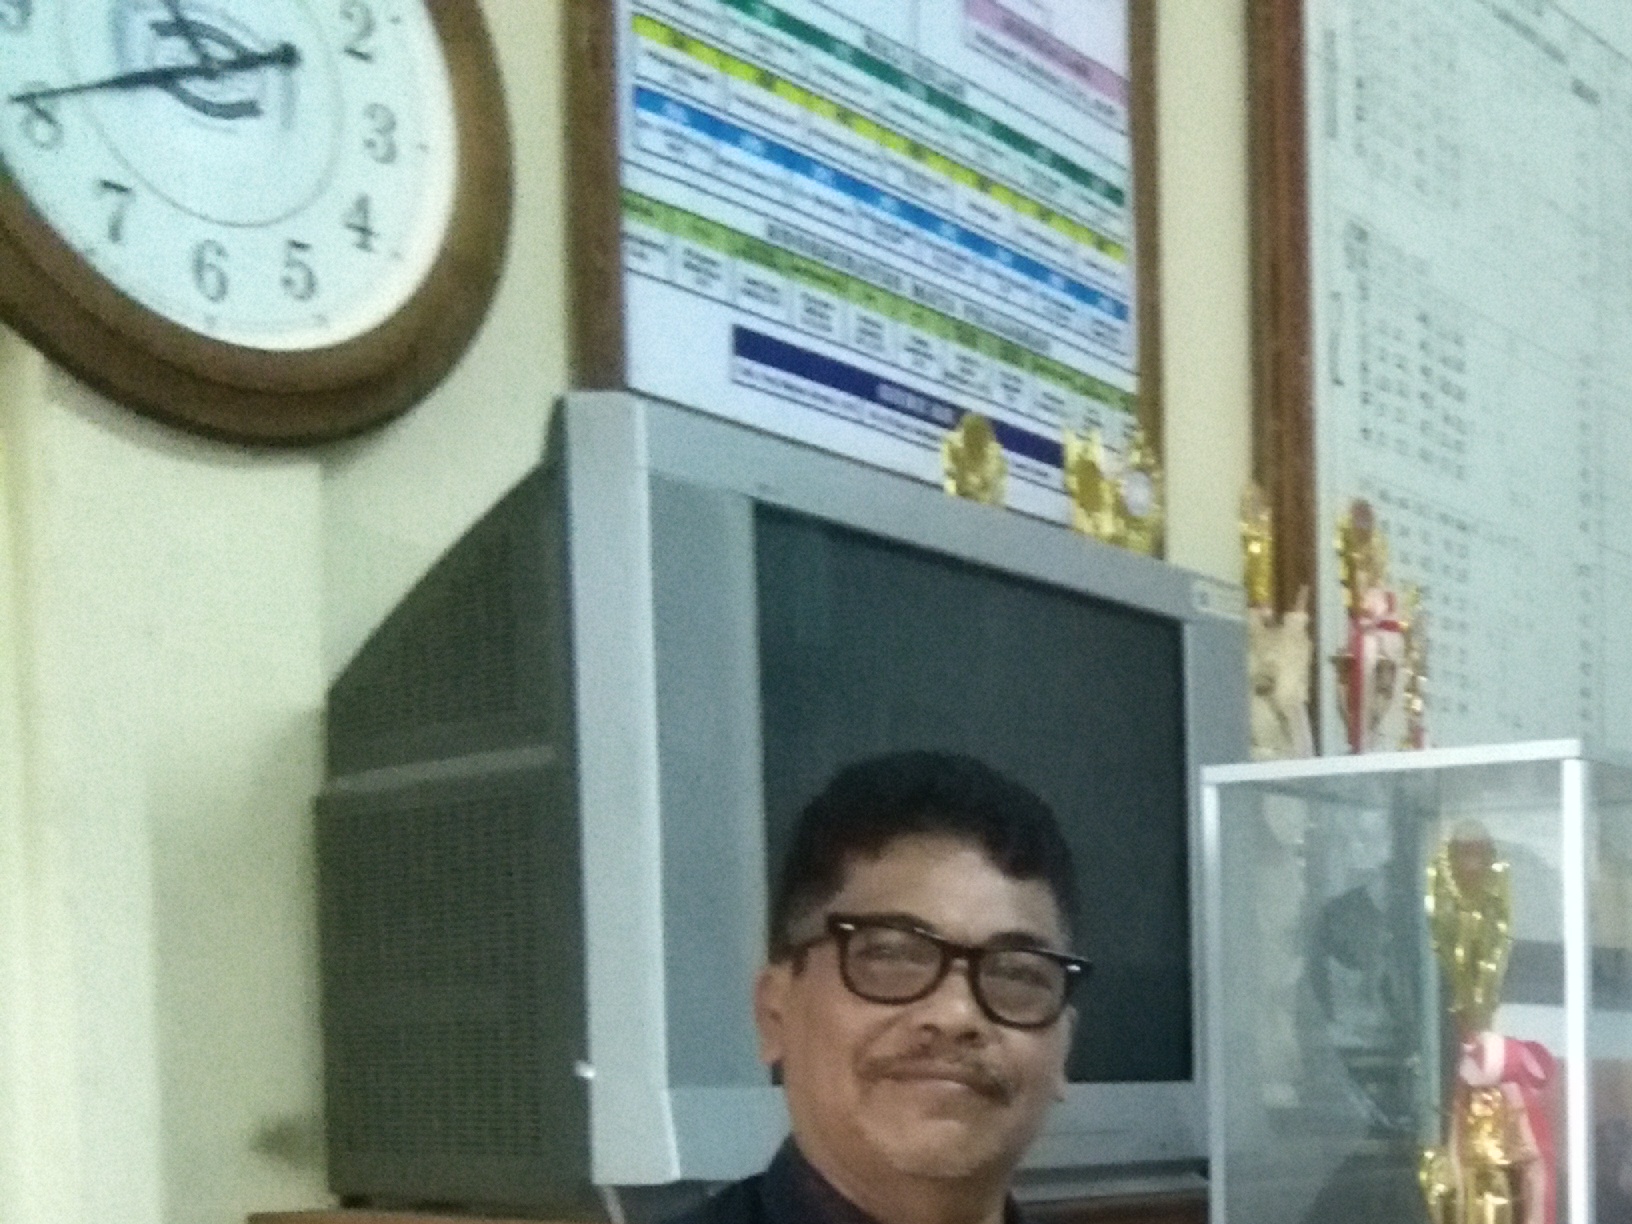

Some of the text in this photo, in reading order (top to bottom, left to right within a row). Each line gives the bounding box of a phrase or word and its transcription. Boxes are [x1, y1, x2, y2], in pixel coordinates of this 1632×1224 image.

[339, 0, 376, 63] 2
[362, 102, 398, 164] 3
[96, 179, 136, 244] 7
[342, 193, 379, 253] 4
[191, 238, 229, 303] 6
[280, 239, 317, 300] 5
